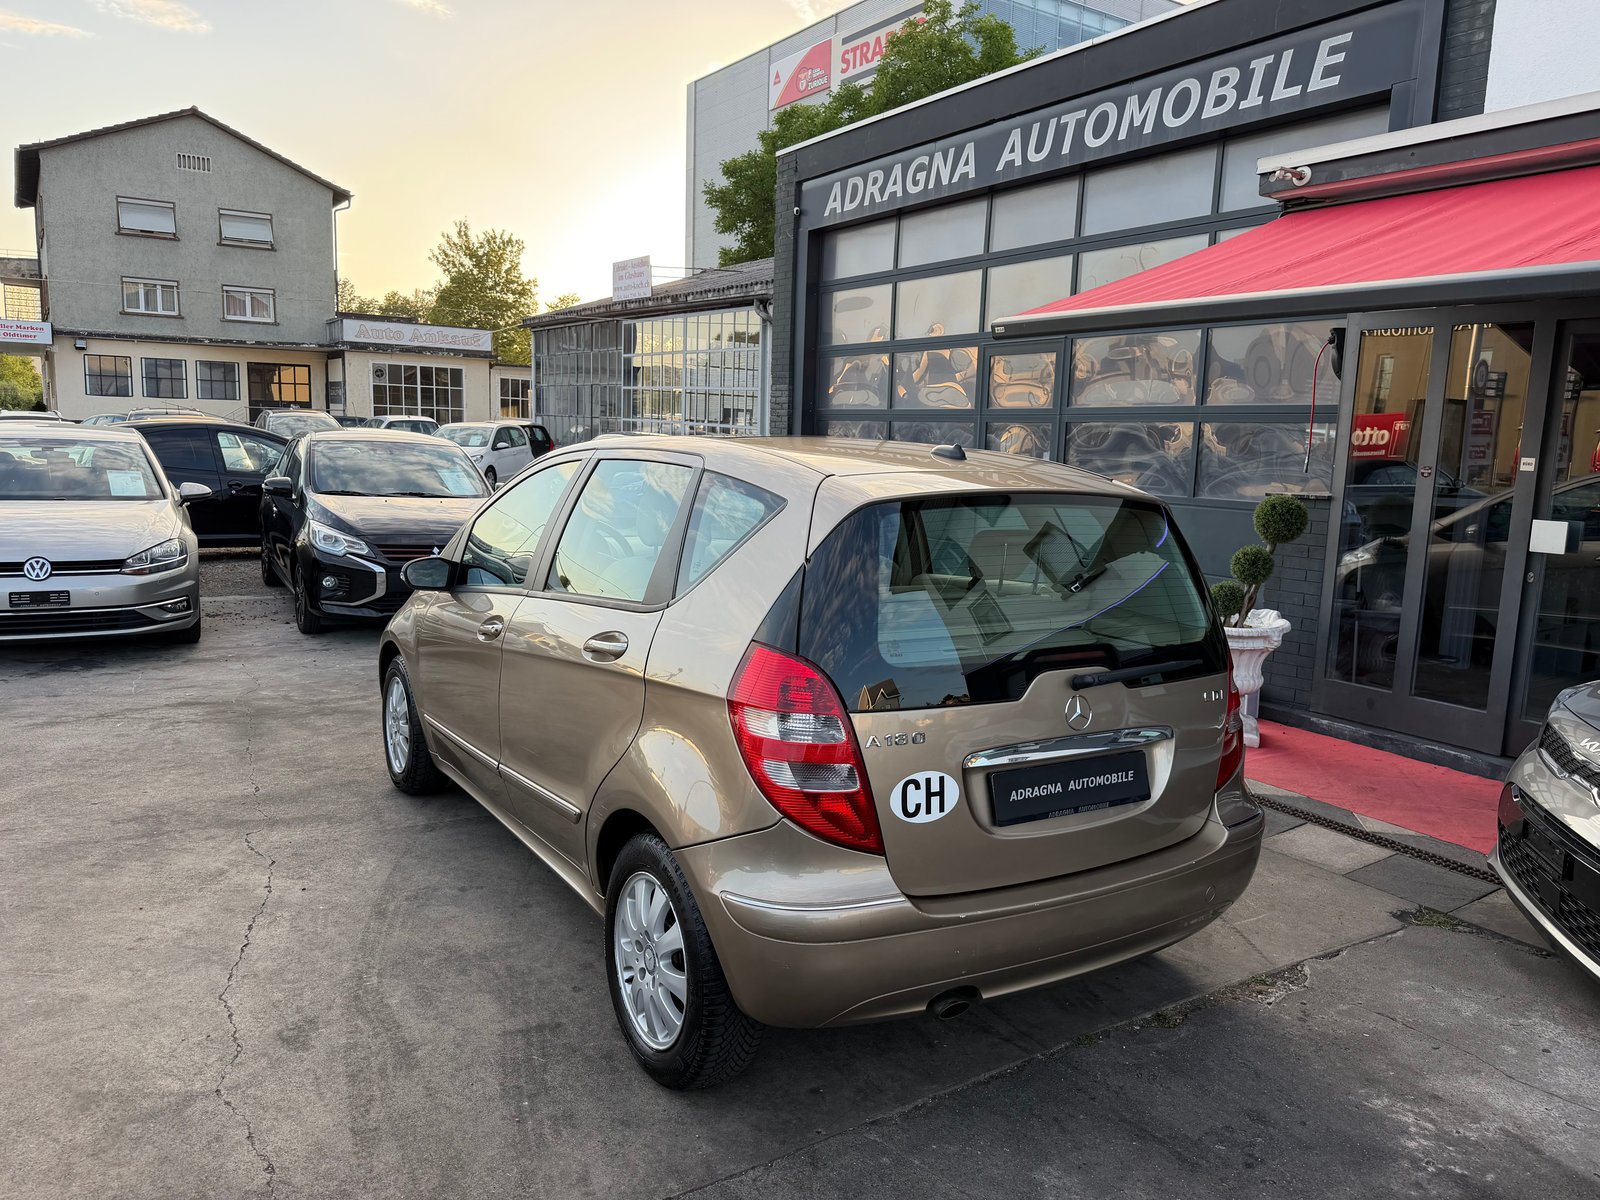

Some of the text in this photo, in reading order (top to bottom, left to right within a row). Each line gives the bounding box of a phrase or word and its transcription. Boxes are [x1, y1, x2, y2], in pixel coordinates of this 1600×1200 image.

[823, 31, 1355, 217] ADRAGNA AUTOMOBILE
[355, 324, 481, 346] Auto Ankauf
[901, 775, 945, 819] CH
[1009, 770, 1135, 802] ADRAGNA AUTOMOBILE
[1048, 801, 1110, 819] ADRAGNA AUTOMOBILE
